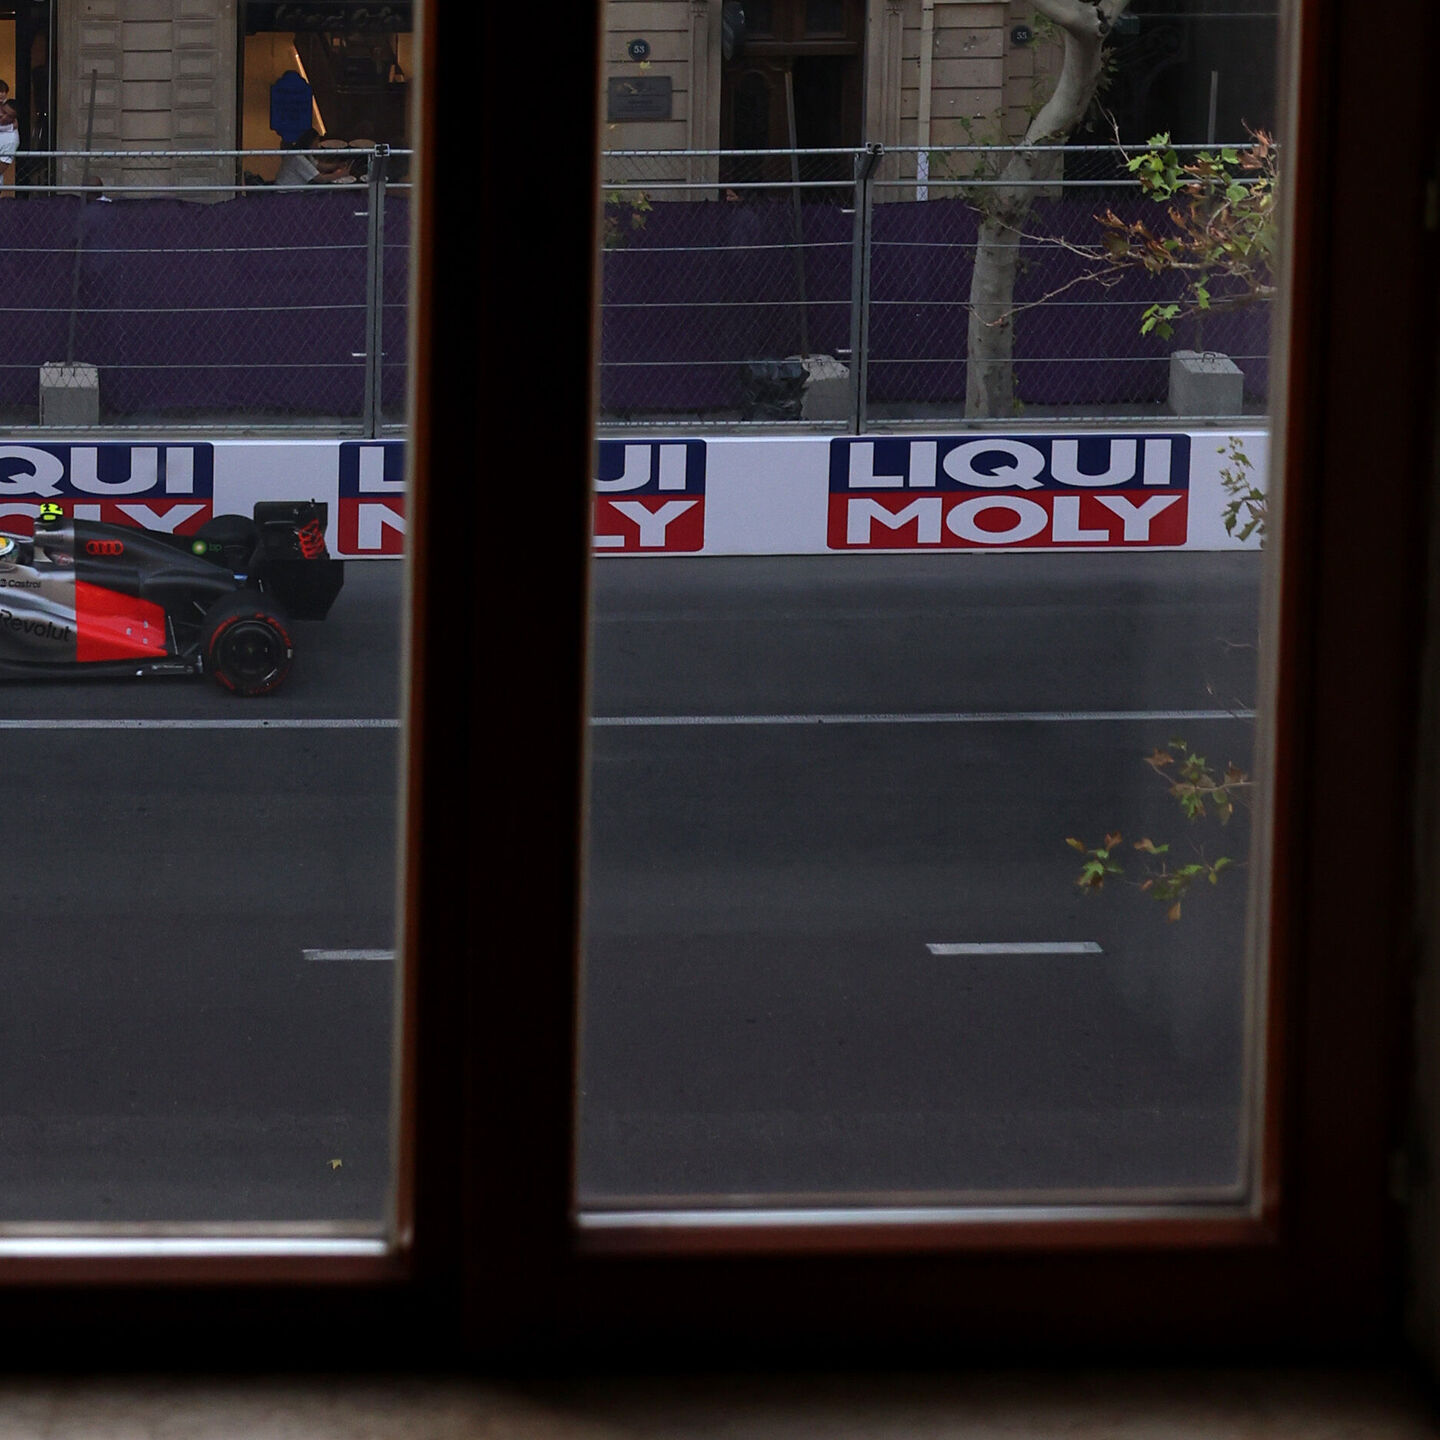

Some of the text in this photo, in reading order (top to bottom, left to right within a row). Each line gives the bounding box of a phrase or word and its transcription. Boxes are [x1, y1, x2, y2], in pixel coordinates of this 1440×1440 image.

[848, 439, 1172, 490] LIQUI
[847, 496, 1181, 545] MOLY
[8, 579, 41, 588] Castrol
